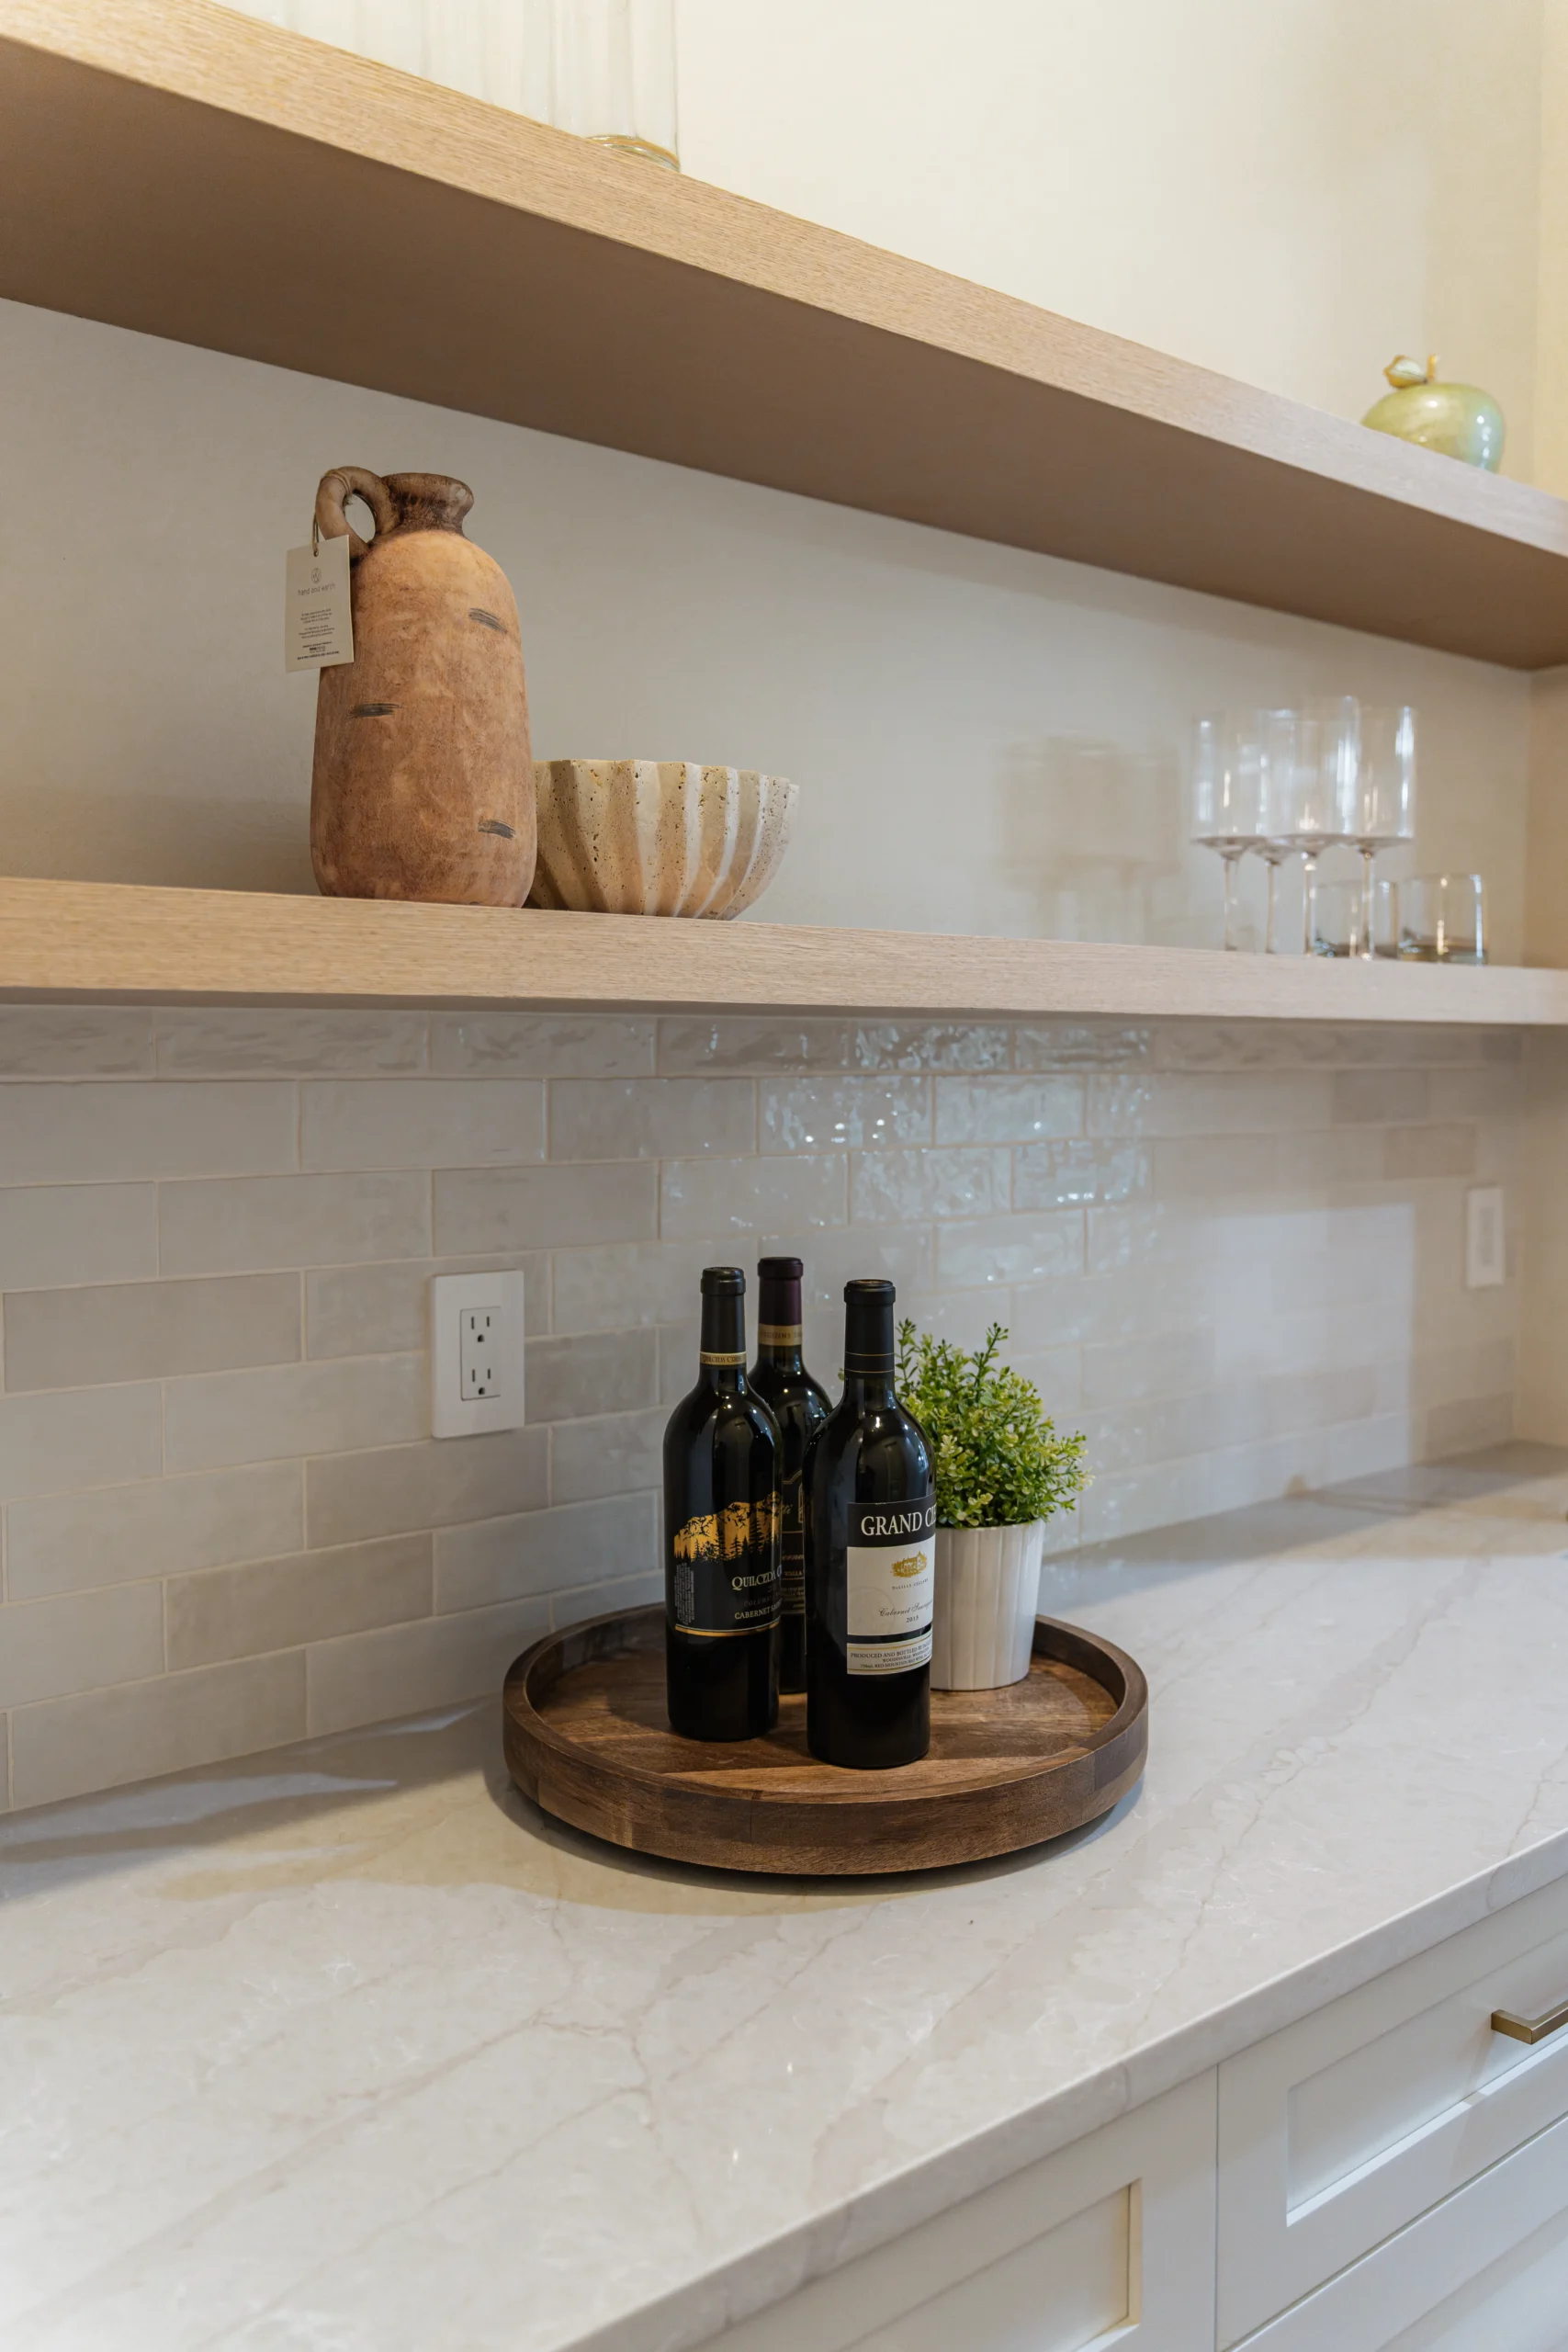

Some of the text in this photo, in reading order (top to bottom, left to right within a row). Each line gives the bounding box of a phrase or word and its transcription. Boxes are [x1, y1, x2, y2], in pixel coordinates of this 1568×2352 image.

[861, 1511, 922, 1536] GRAND
[731, 1570, 776, 1591] QUILCEDA
[734, 1605, 771, 1620] CABERNET
[878, 1607, 911, 1617] Cabernet
[896, 1647, 918, 1657] BOTTLED
